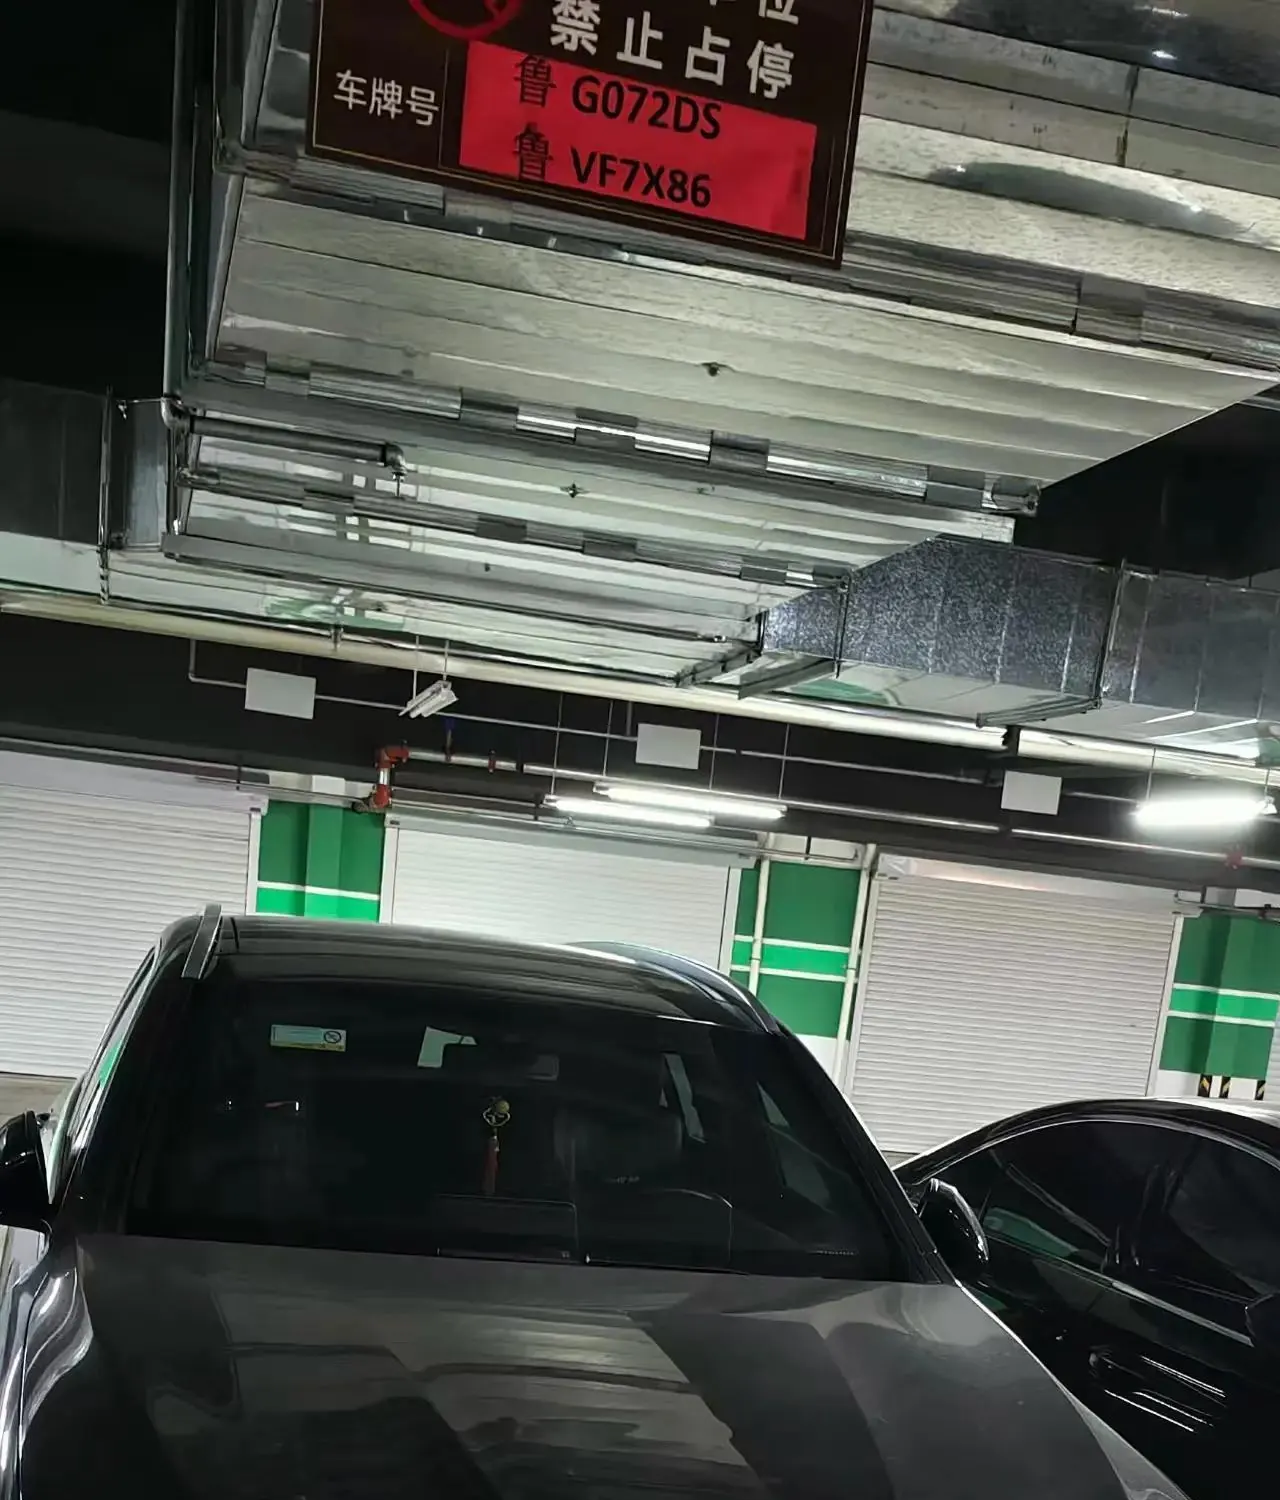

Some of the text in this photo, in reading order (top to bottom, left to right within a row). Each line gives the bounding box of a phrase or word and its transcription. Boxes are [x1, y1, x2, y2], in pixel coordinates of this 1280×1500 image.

[549, 0, 796, 99] 禁止占停
[333, 69, 439, 126] 车牌号
[514, 54, 722, 140] 鲁 G072DS
[512, 122, 711, 207] 鲁 VF7X86
